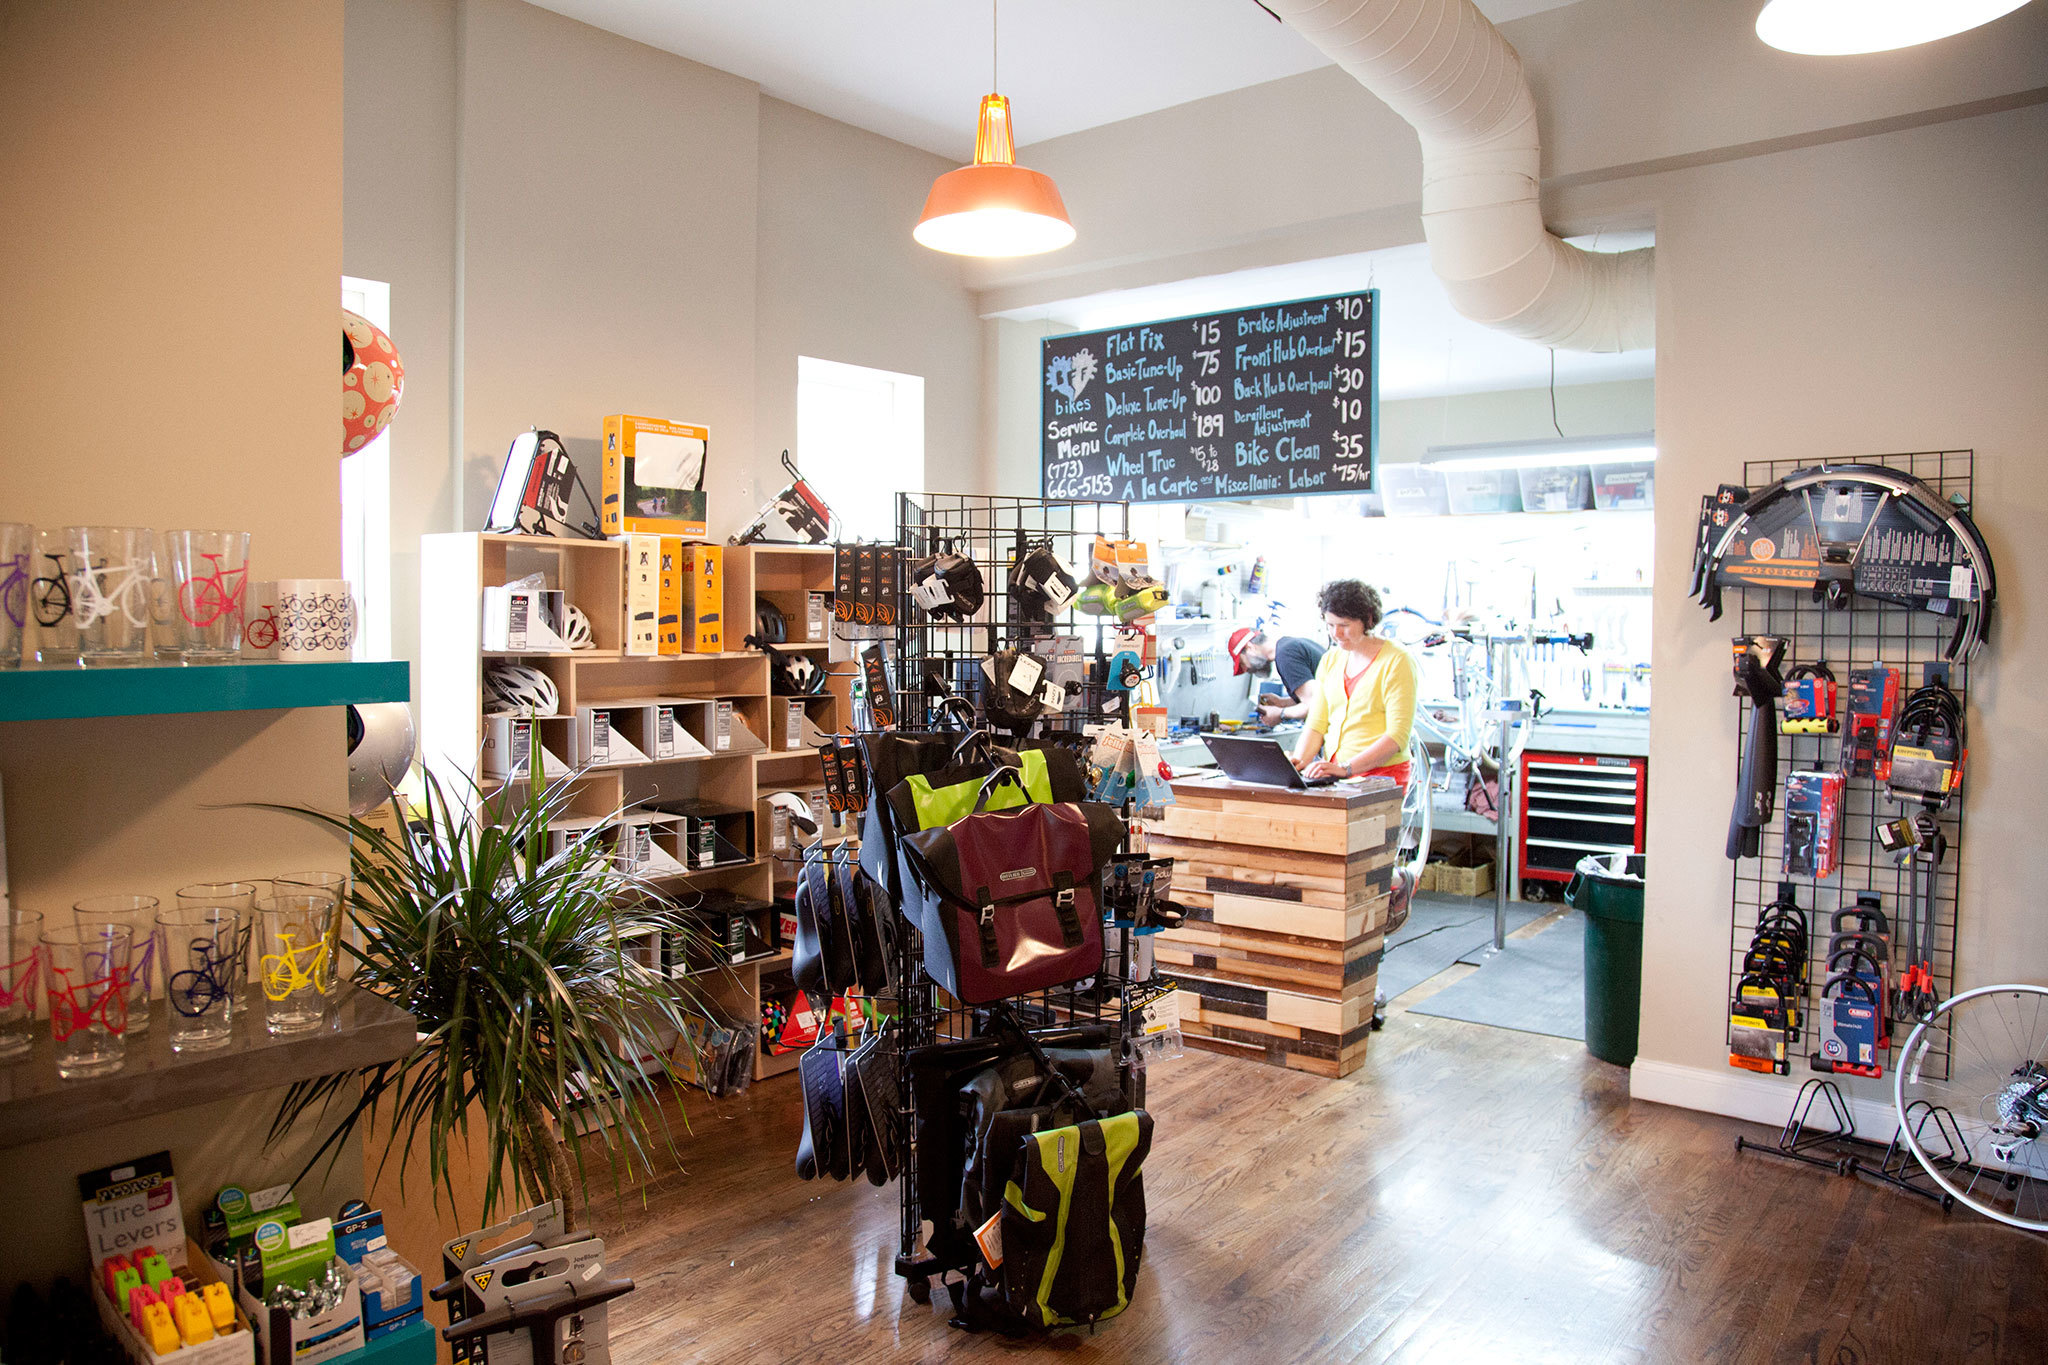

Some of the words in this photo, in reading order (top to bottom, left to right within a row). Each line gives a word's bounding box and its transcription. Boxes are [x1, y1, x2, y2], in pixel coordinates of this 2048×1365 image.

[1238, 312, 1275, 336] Brake
[1276, 304, 1329, 333] Adjustment
[1336, 297, 1363, 321] $10
[1107, 332, 1134, 358] Flat
[1140, 328, 1165, 351] Fix
[1192, 320, 1221, 346] $15
[1235, 343, 1272, 371] Front
[1273, 336, 1296, 363] Hub
[1297, 335, 1335, 358] Overhaul
[1335, 328, 1366, 358] $15
[1105, 362, 1136, 384] Basic
[1135, 355, 1183, 383] Tune-Up
[1193, 349, 1221, 377] $75
[1234, 376, 1262, 401] Back
[1263, 371, 1285, 399] Hub
[1287, 371, 1332, 395] Overhaul
[1333, 364, 1364, 394] $30
[1055, 398, 1091, 416] bikes
[1105, 392, 1141, 418] Deluxe
[1144, 386, 1187, 413] Tune-Up
[1190, 380, 1221, 406] $100
[1234, 404, 1284, 424] Derailleur
[1048, 416, 1098, 441] Service
[1105, 424, 1144, 446] Complete
[1148, 419, 1186, 440] Overhaul
[1192, 411, 1223, 439] $189
[1254, 410, 1312, 437] Adjustment
[1332, 396, 1362, 424] $10
[1057, 439, 1100, 460] Menu
[1106, 452, 1144, 477] Wheel
[1148, 449, 1175, 472] True
[1210, 444, 1218, 457] to
[1235, 439, 1269, 467] Bike
[1275, 436, 1320, 462] Clean
[1332, 430, 1363, 459] $35
[1047, 460, 1083, 479] (773)
[1047, 474, 1114, 499] 666-5153
[1121, 481, 1135, 499] A
[1142, 477, 1156, 500] la
[1160, 475, 1198, 497] Carte
[1289, 468, 1327, 490] Labor
[1332, 463, 1370, 484] $75/hr
[1849, 1009, 1871, 1017] ABUS
[93, 1203, 145, 1228] Tire
[345, 1222, 368, 1234] GP-2
[99, 1218, 177, 1253] Levers
[574, 1263, 585, 1271] Pro
